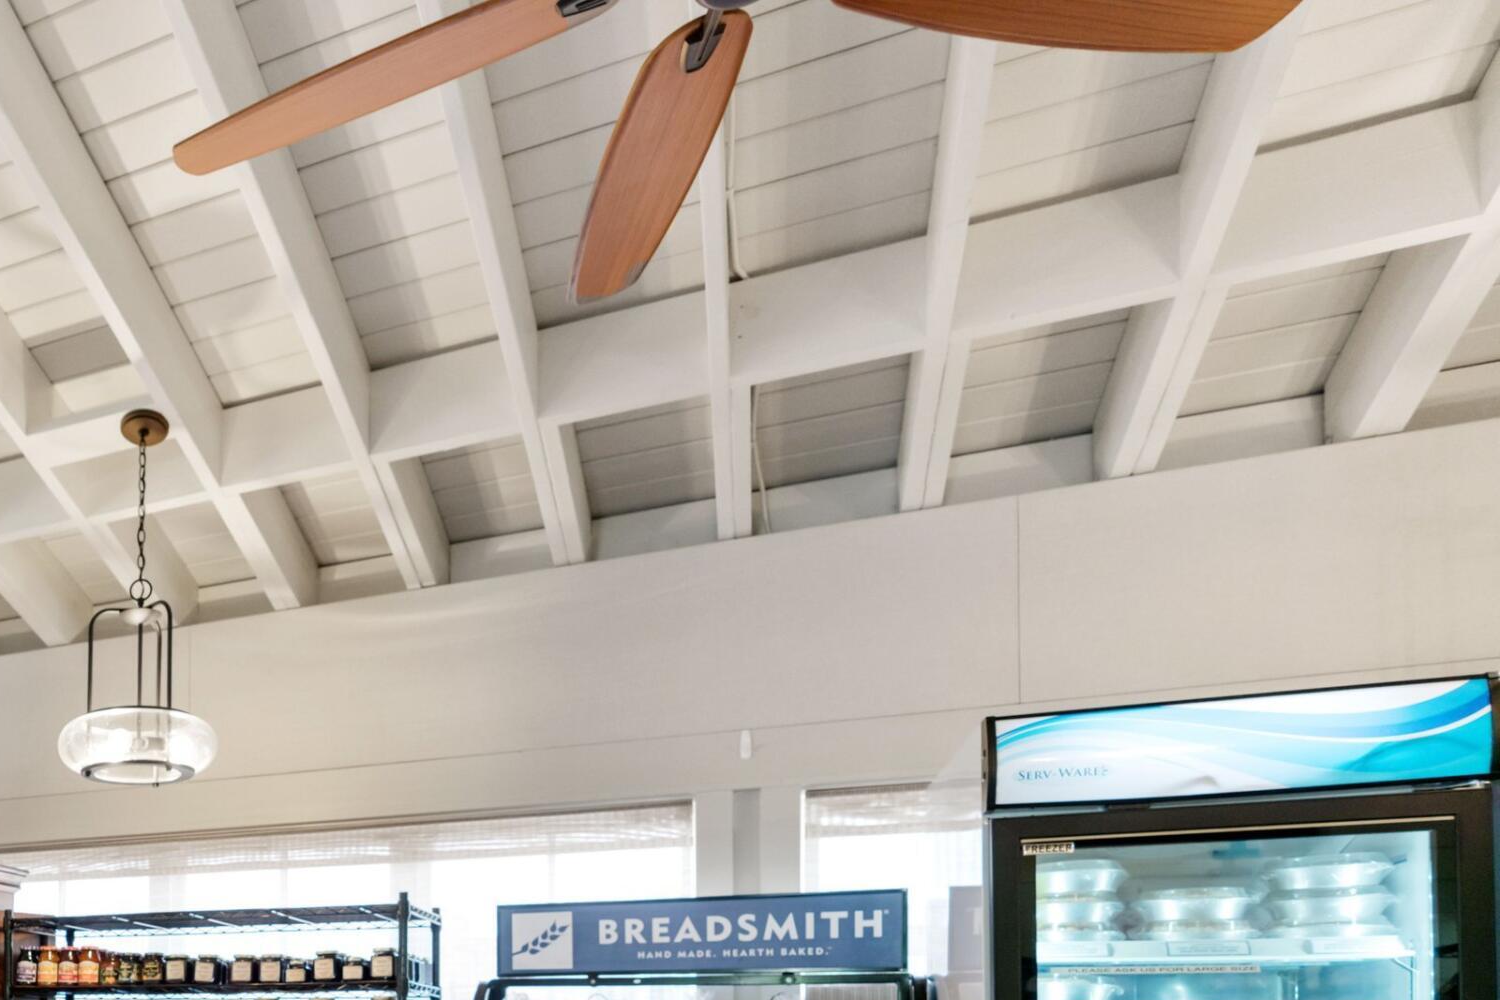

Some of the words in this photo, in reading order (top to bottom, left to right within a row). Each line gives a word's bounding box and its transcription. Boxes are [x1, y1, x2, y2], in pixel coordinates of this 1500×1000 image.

[1024, 843, 1073, 854] FREEZER
[598, 909, 883, 945] BREADSMITH
[637, 950, 672, 960] HAND
[677, 949, 717, 959] MADE.
[722, 947, 775, 958] HEARTH
[780, 946, 829, 957] BAKED.
